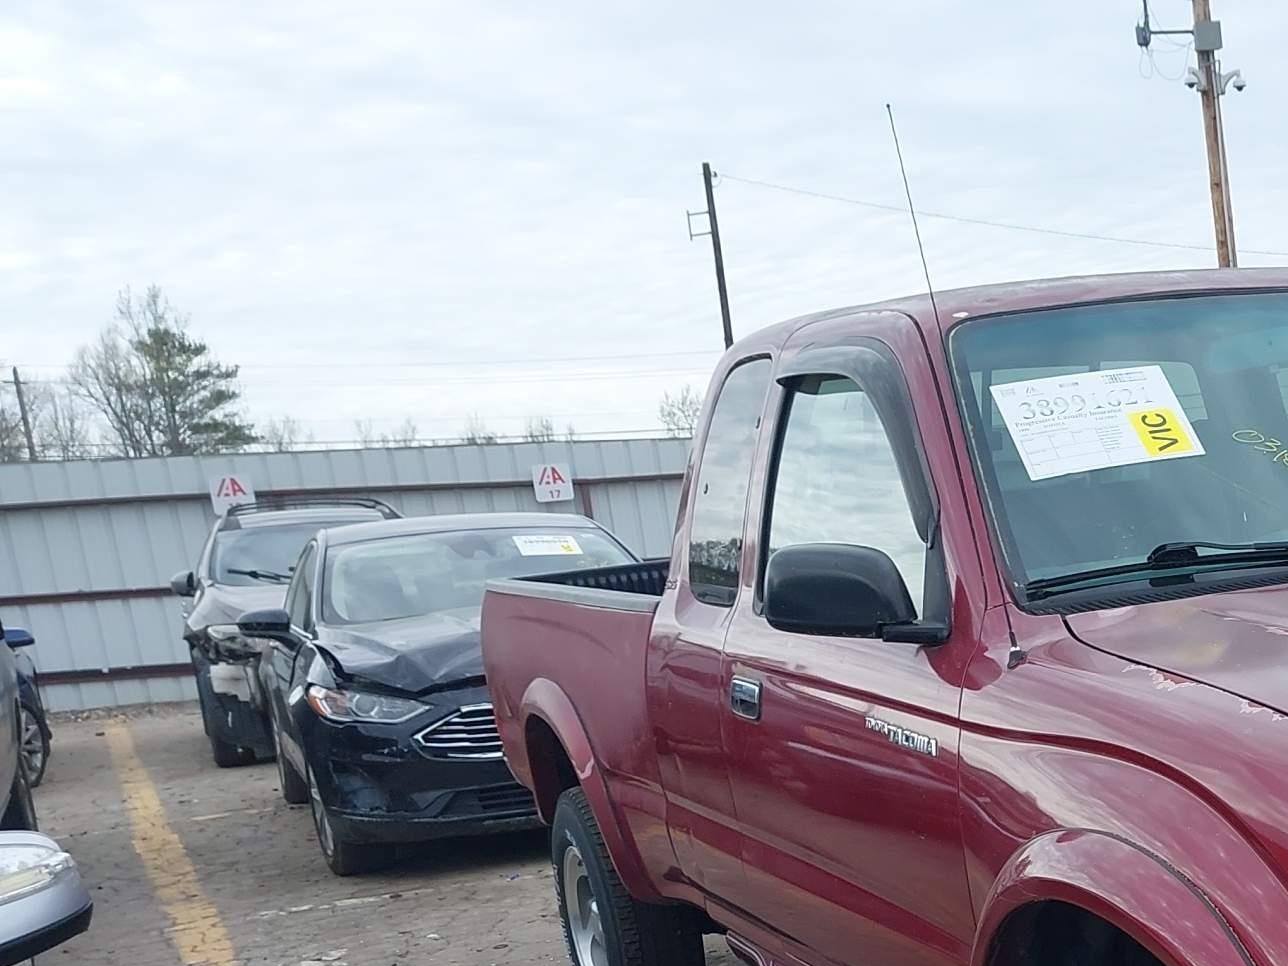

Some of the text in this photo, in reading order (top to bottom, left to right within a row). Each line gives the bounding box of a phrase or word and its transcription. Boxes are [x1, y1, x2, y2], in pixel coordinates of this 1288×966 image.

[1141, 413, 1179, 452] VIC
[549, 490, 561, 499] 17
[888, 725, 938, 757] TACOMA
